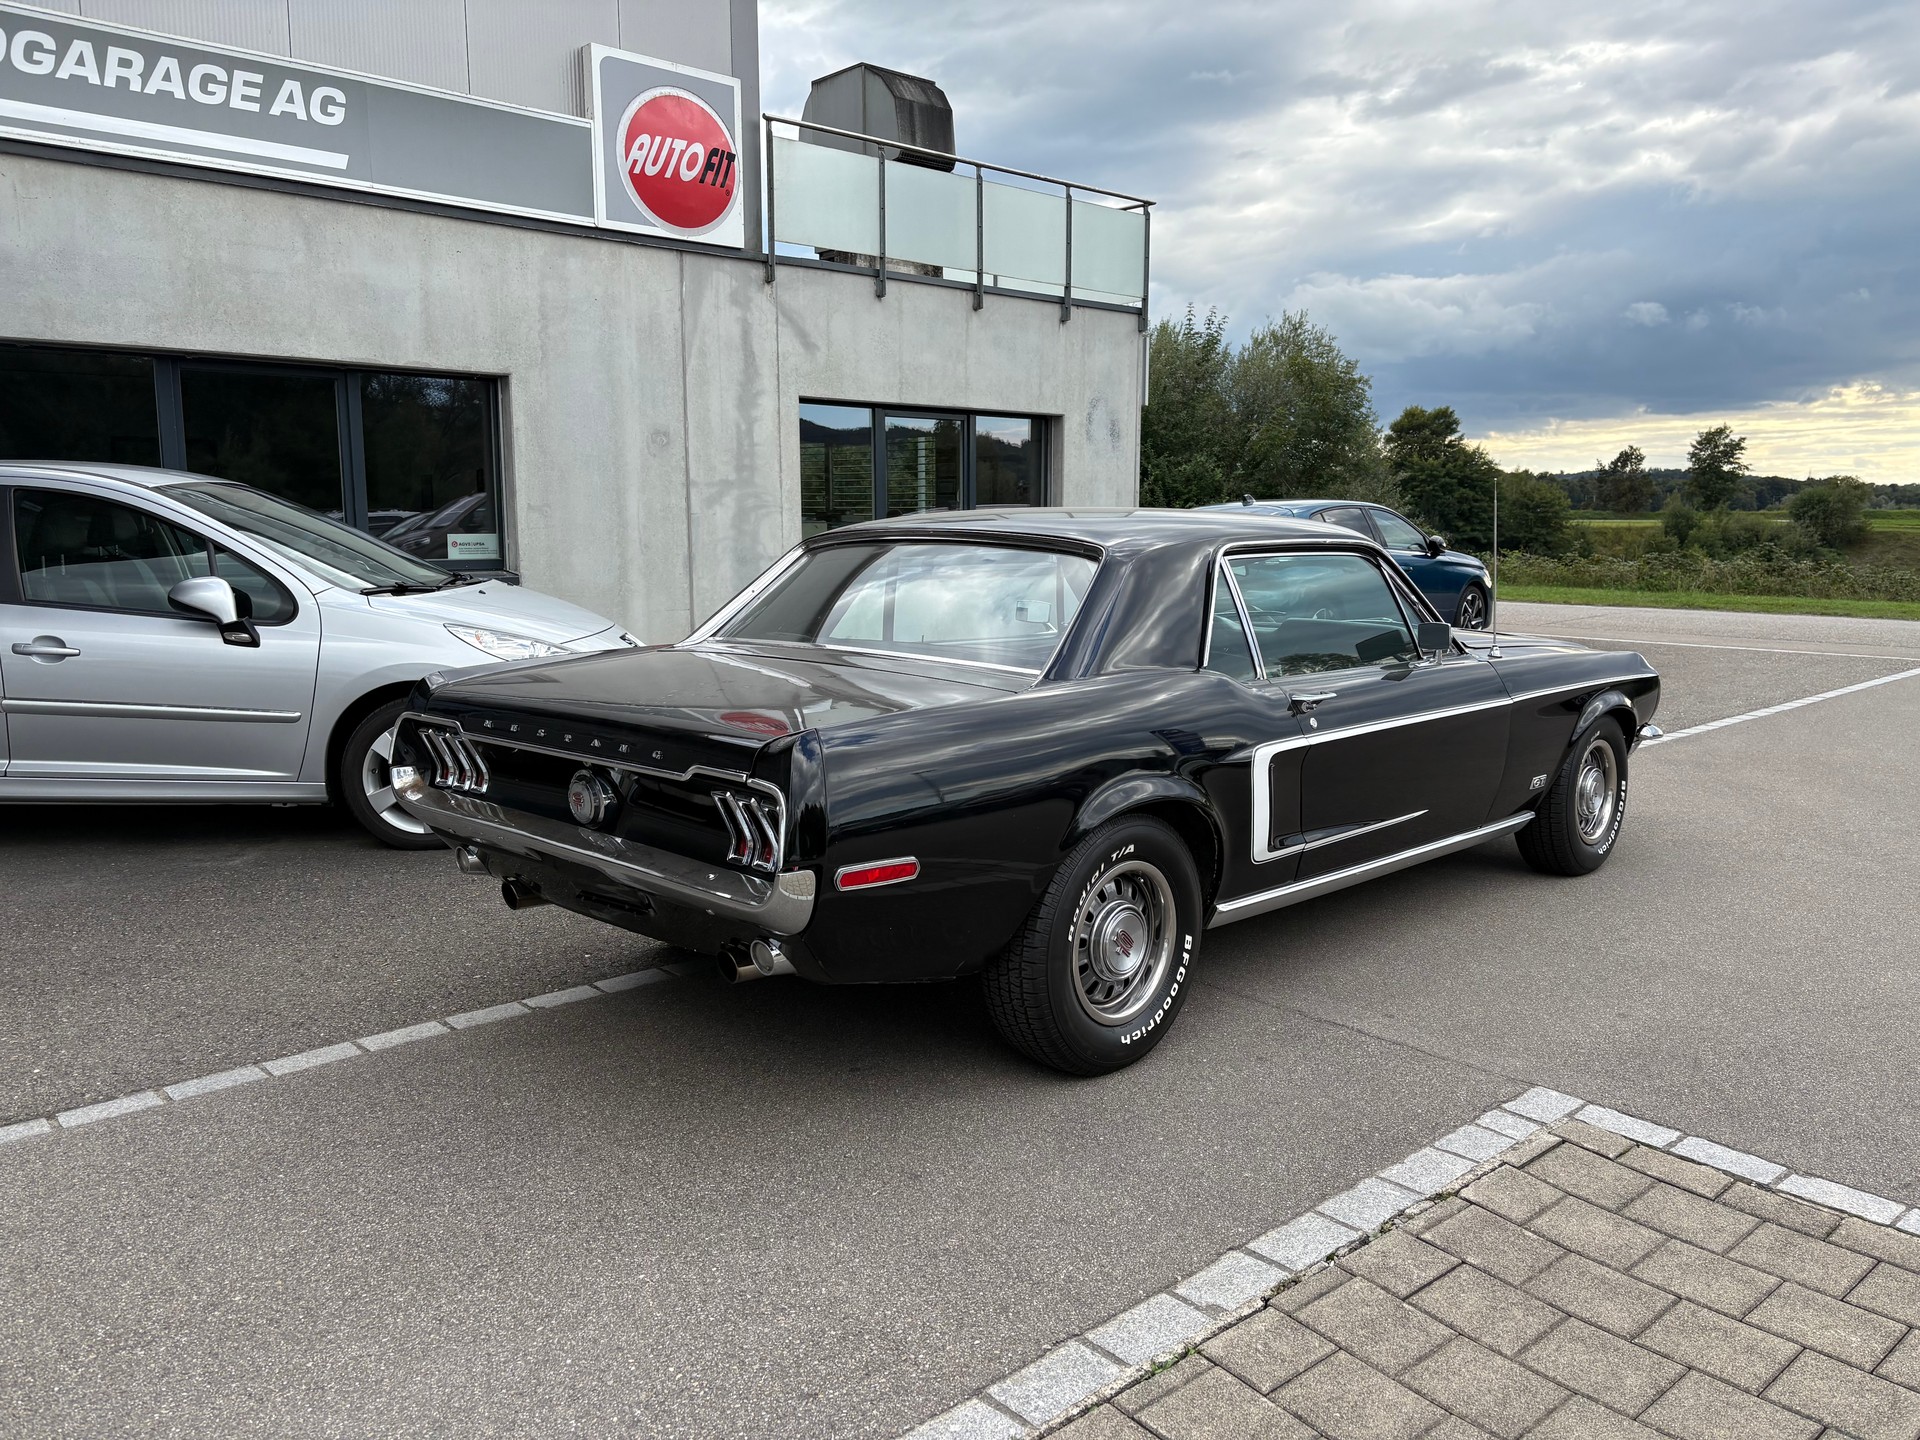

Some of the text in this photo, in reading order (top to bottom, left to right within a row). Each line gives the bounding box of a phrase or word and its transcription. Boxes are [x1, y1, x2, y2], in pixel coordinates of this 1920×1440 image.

[0, 27, 347, 126] GARAGE AG
[626, 133, 736, 189] AUTOFIT
[483, 719, 664, 760] MUSTANG
[1532, 777, 1546, 788] GT
[1067, 844, 1135, 942] Radial T/A
[1120, 934, 1193, 1045] BFGoodrich
